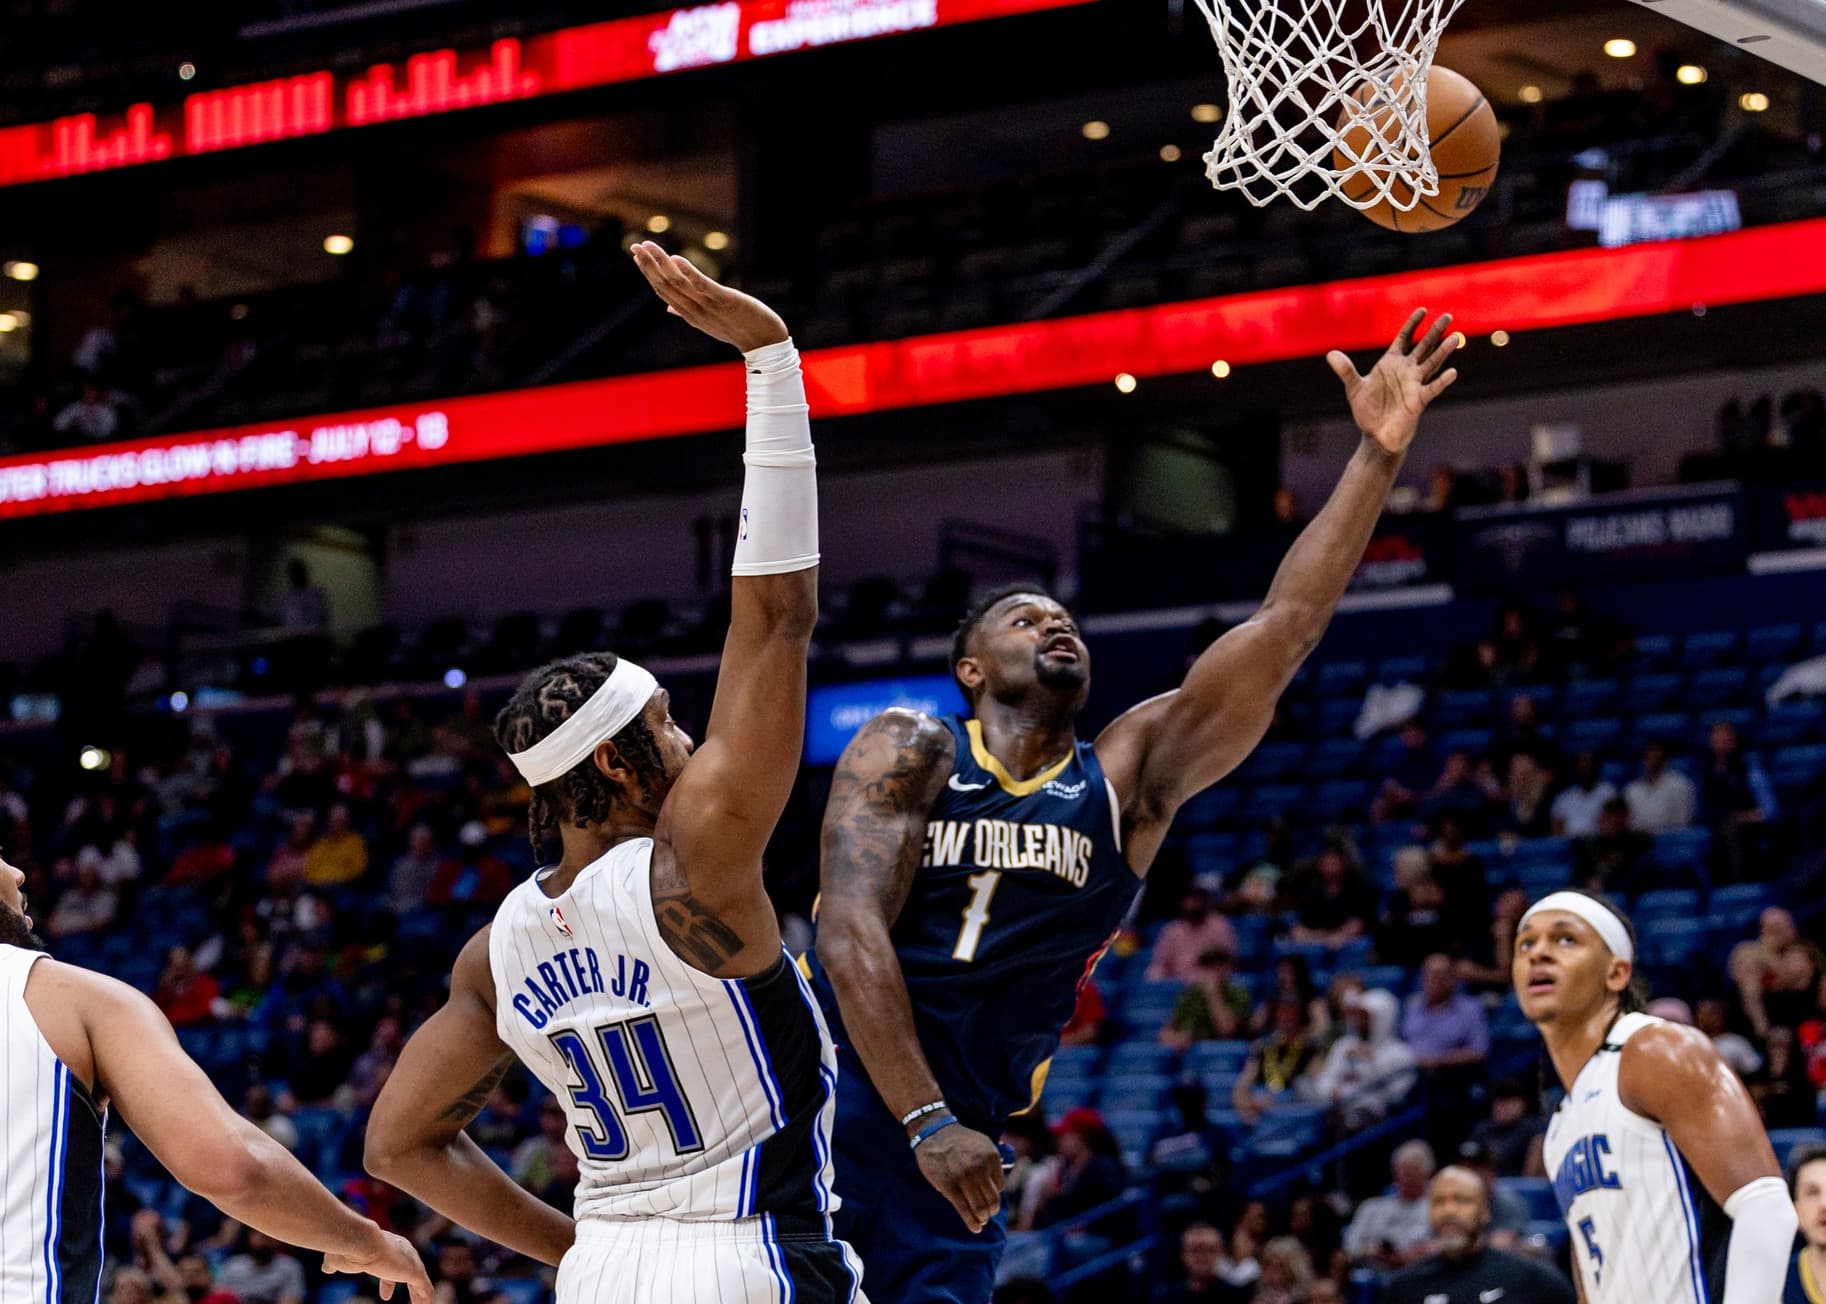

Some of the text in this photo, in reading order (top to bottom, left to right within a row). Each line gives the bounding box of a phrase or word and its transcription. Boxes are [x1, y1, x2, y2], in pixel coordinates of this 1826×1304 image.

[923, 818, 1093, 888] EW ORLEANS
[952, 870, 1002, 963] 1
[512, 947, 650, 1030] CARTER JR.
[547, 1013, 705, 1161] 34
[1577, 1214, 1604, 1286] 5
